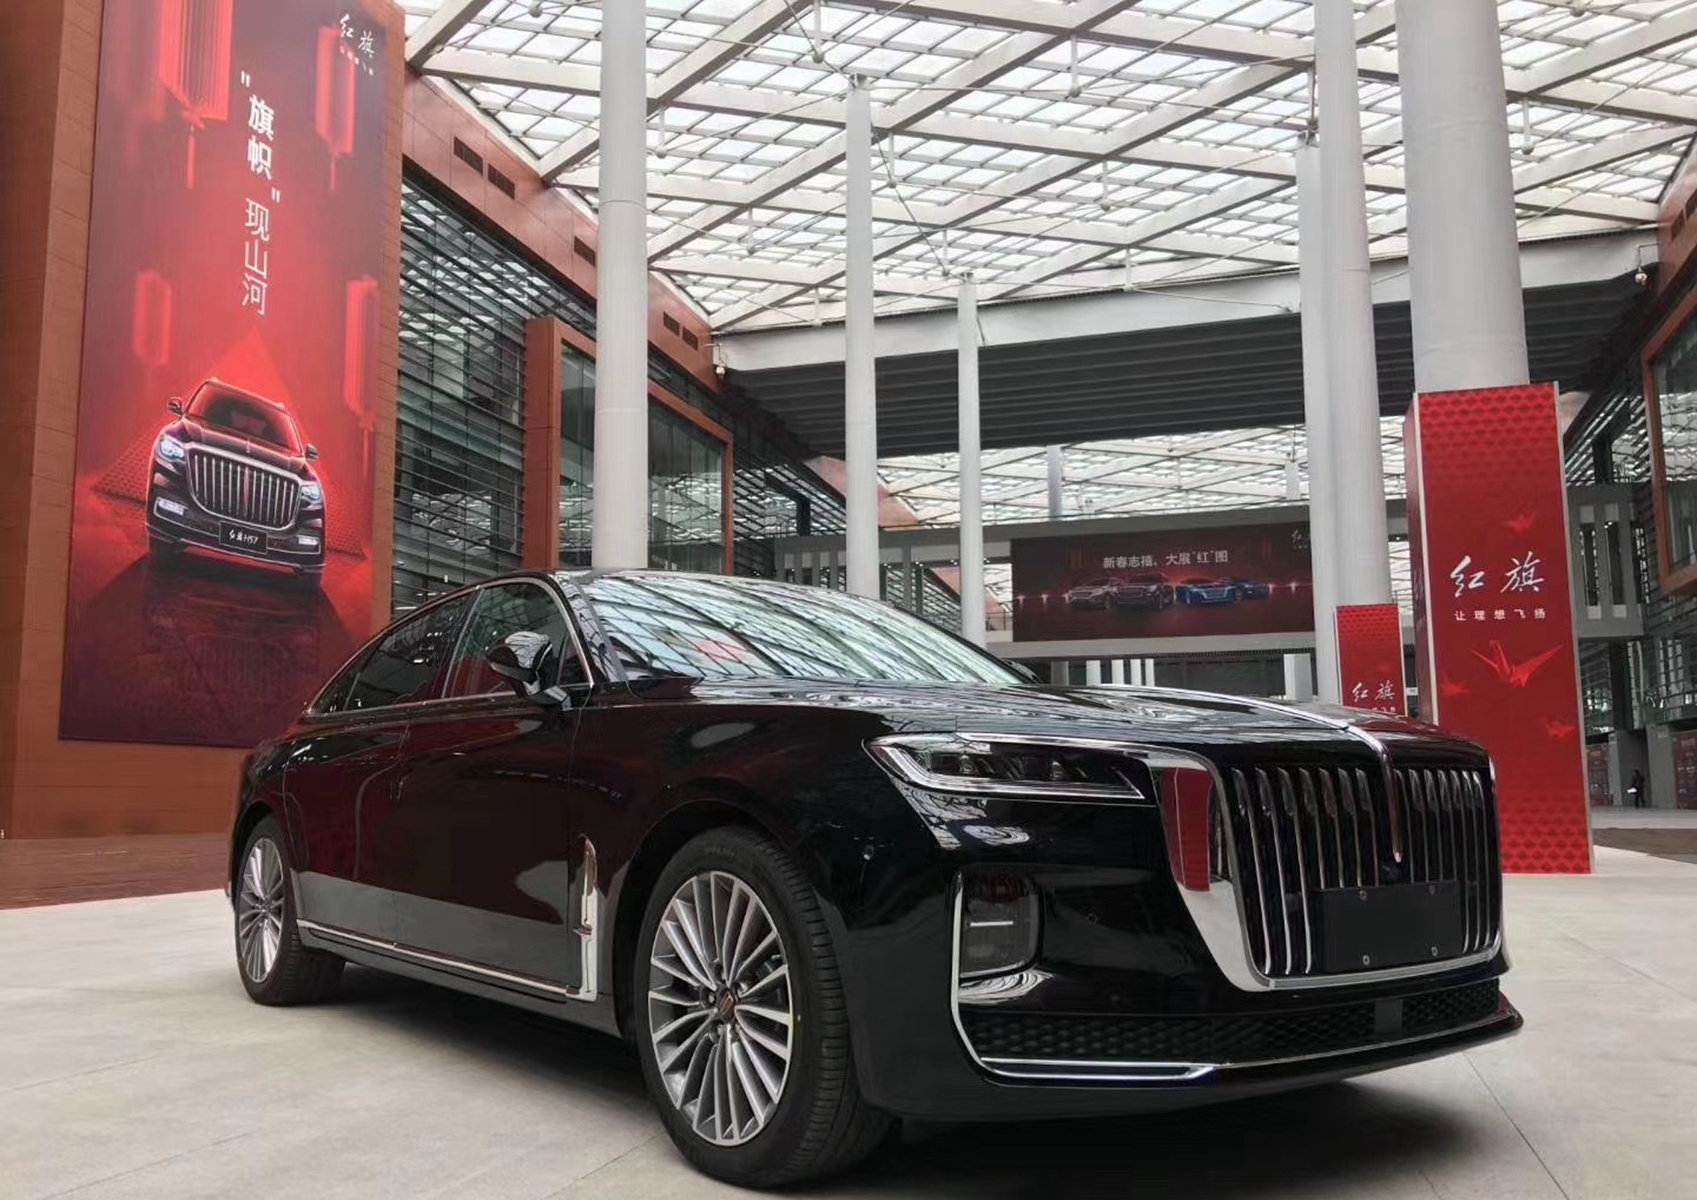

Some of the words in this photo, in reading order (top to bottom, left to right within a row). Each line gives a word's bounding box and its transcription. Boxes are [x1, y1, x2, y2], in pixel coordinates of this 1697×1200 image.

[340, 13, 375, 59] 红旗
[1450, 551, 1546, 599] 红旗
[1454, 608, 1546, 621] 让理想飞扬
[1352, 680, 1396, 703] 红旗
